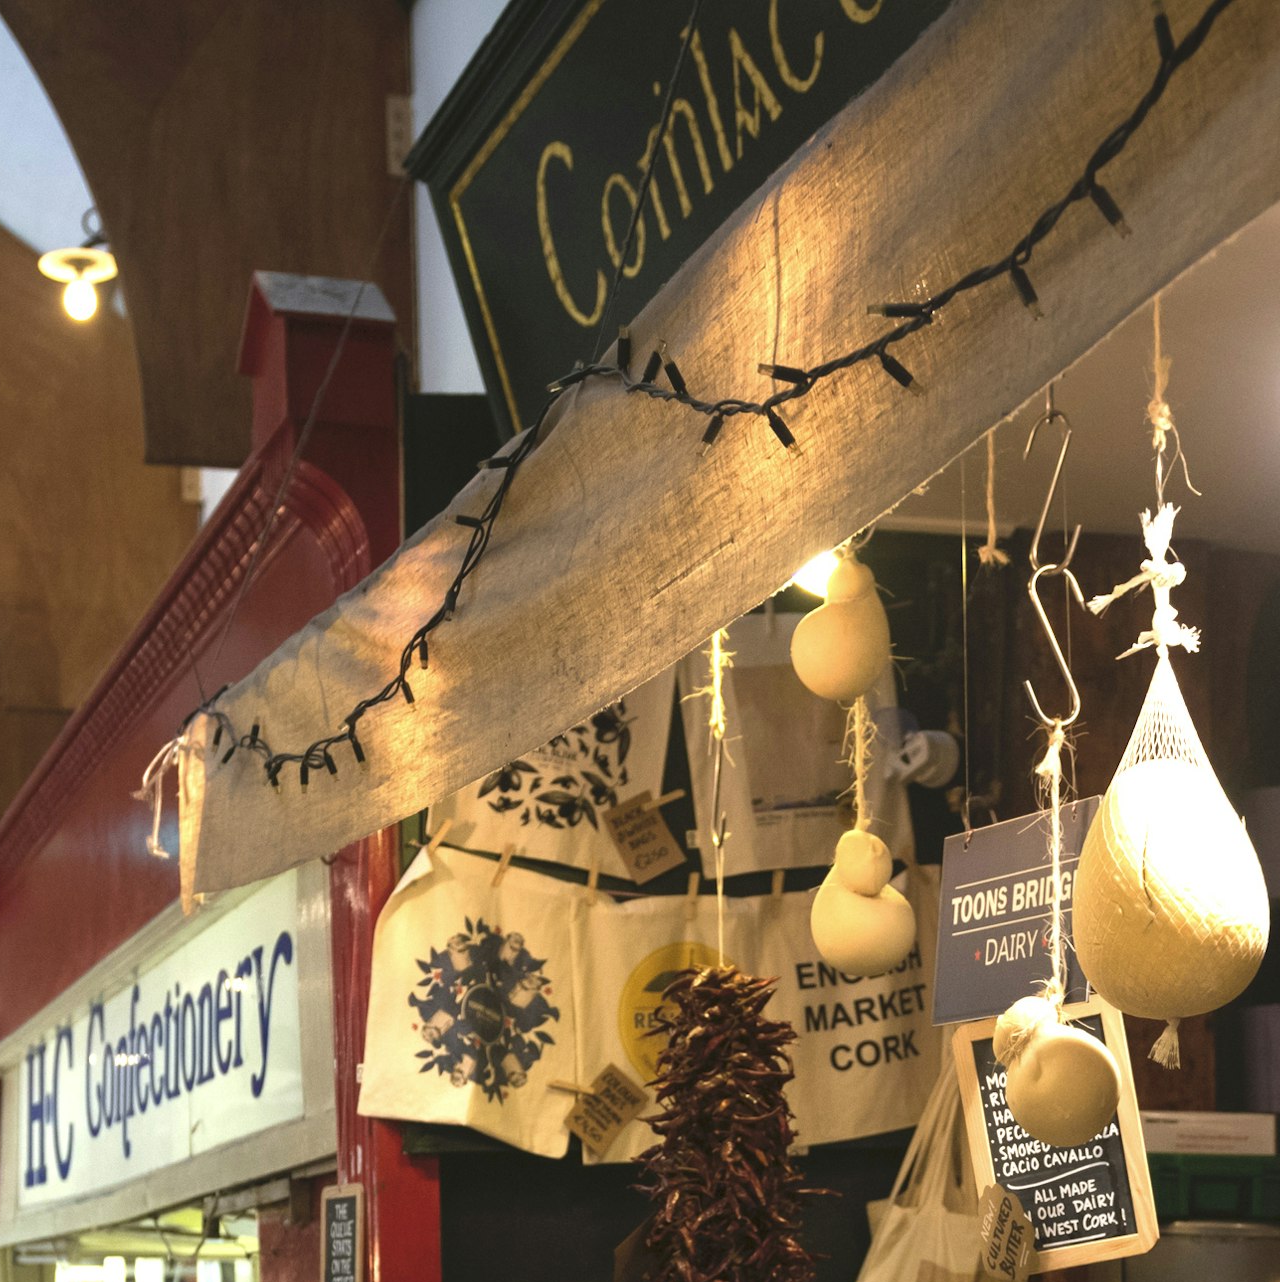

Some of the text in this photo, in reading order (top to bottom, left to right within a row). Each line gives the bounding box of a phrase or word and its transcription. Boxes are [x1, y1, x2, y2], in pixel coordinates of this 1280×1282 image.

[985, 929, 1039, 966] DAIRY
[804, 984, 927, 1033] MARKET
[85, 931, 293, 1159] Confectionery
[830, 1030, 920, 1072] CORK
[1044, 1145, 1103, 1168] CAVALLO
[1034, 1178, 1098, 1205] ALL MADE
[1037, 1203, 1065, 1221] OUR
[1073, 1191, 1116, 1214] DAIRY
[335, 1203, 349, 1220] THE
[1043, 1218, 1080, 1238] WEST
[986, 1196, 1013, 1270] CULTURED
[999, 1220, 1026, 1281] BUTTER
